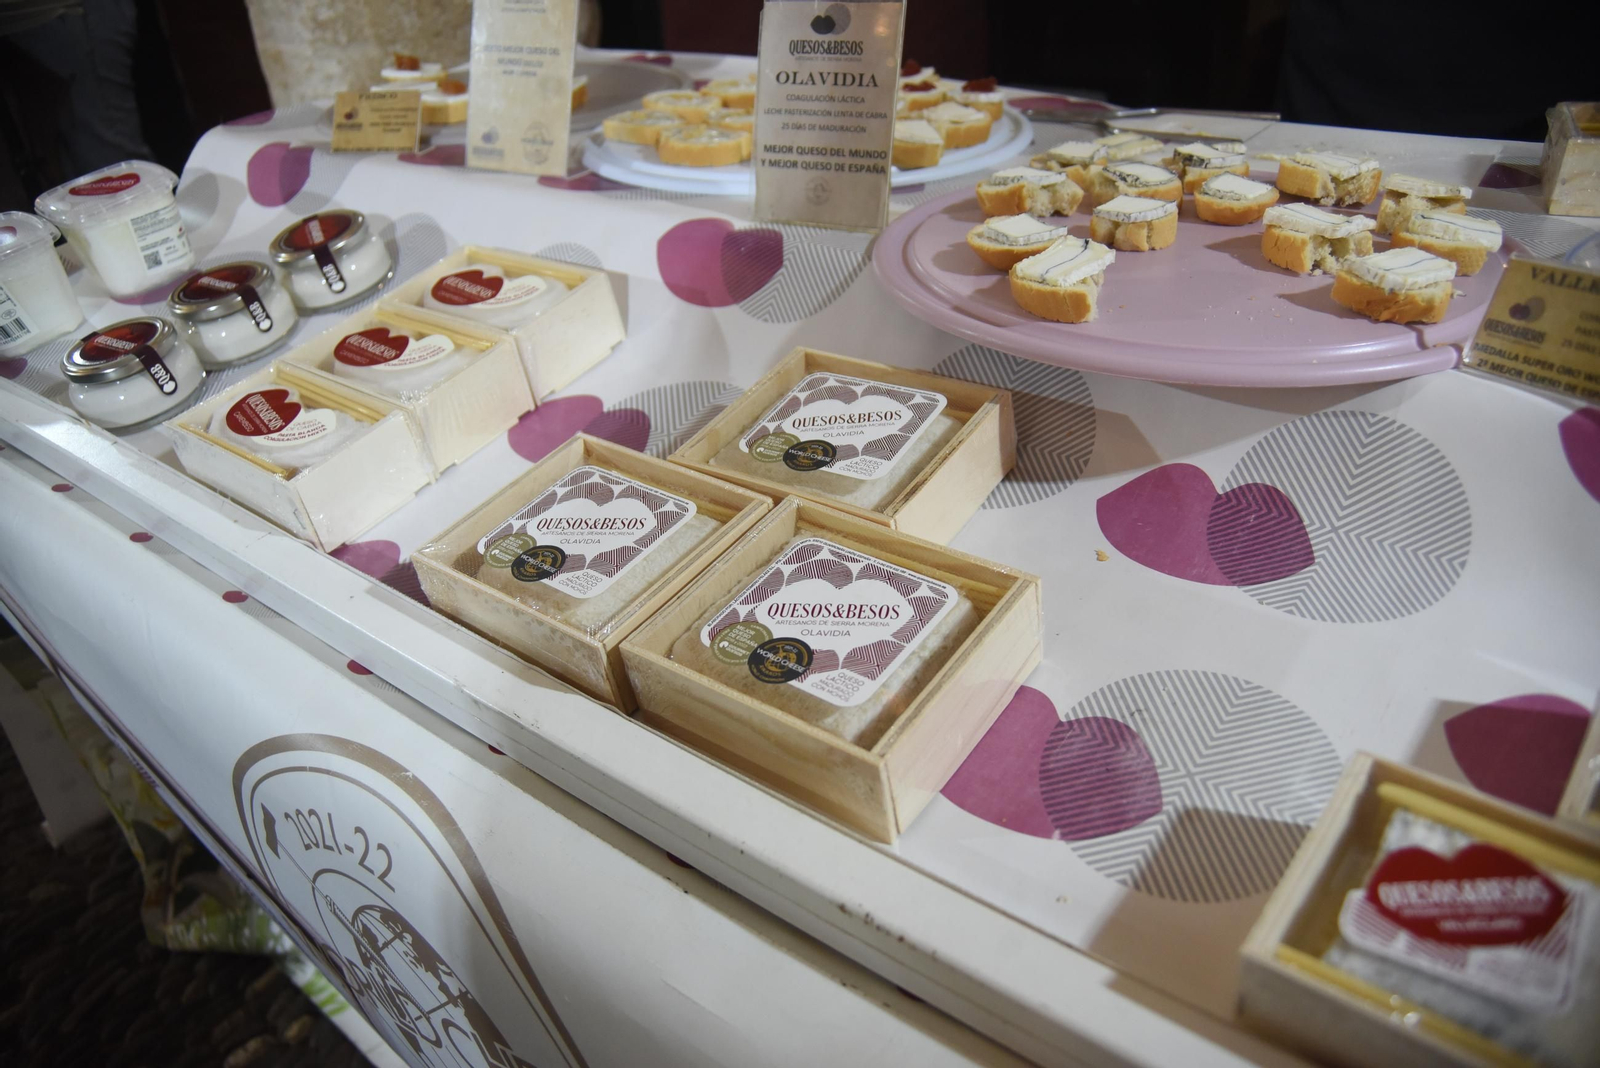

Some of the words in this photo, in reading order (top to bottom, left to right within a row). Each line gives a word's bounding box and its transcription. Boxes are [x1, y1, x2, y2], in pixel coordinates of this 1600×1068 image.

[789, 40, 863, 56] QUESOS&BESOS
[775, 70, 879, 88] OLAVIDIA
[833, 110, 854, 118] LENTA
[763, 144, 794, 154] MEJOR
[796, 146, 828, 157] QUESO
[829, 147, 846, 158] DEL
[849, 149, 888, 160] MUNDO
[760, 159, 767, 167] Y
[768, 159, 798, 169] MEJOR
[801, 161, 832, 172] QUESO
[834, 163, 846, 173] DE
[848, 163, 887, 175] ESPAÑA
[1473, 342, 1519, 362] MEDALLA
[1522, 355, 1555, 372] SUPER
[1556, 364, 1581, 378] ORO
[1489, 361, 1523, 380] MEJOR
[1525, 372, 1562, 390] QUESO
[1563, 382, 1578, 394] DE
[792, 410, 902, 430] QUESOS&BESOS
[822, 430, 865, 438] OLAVIDIA
[536, 517, 647, 532] QUESOS&BESOS
[582, 571, 603, 583] QUESO
[767, 602, 900, 620] QUESOS&BESOS
[800, 629, 851, 637] OLAVIDIA
[757, 647, 782, 663] WORLD
[811, 682, 826, 691] CON
[838, 672, 865, 686] QUESO
[284, 808, 396, 893] 2021-22
